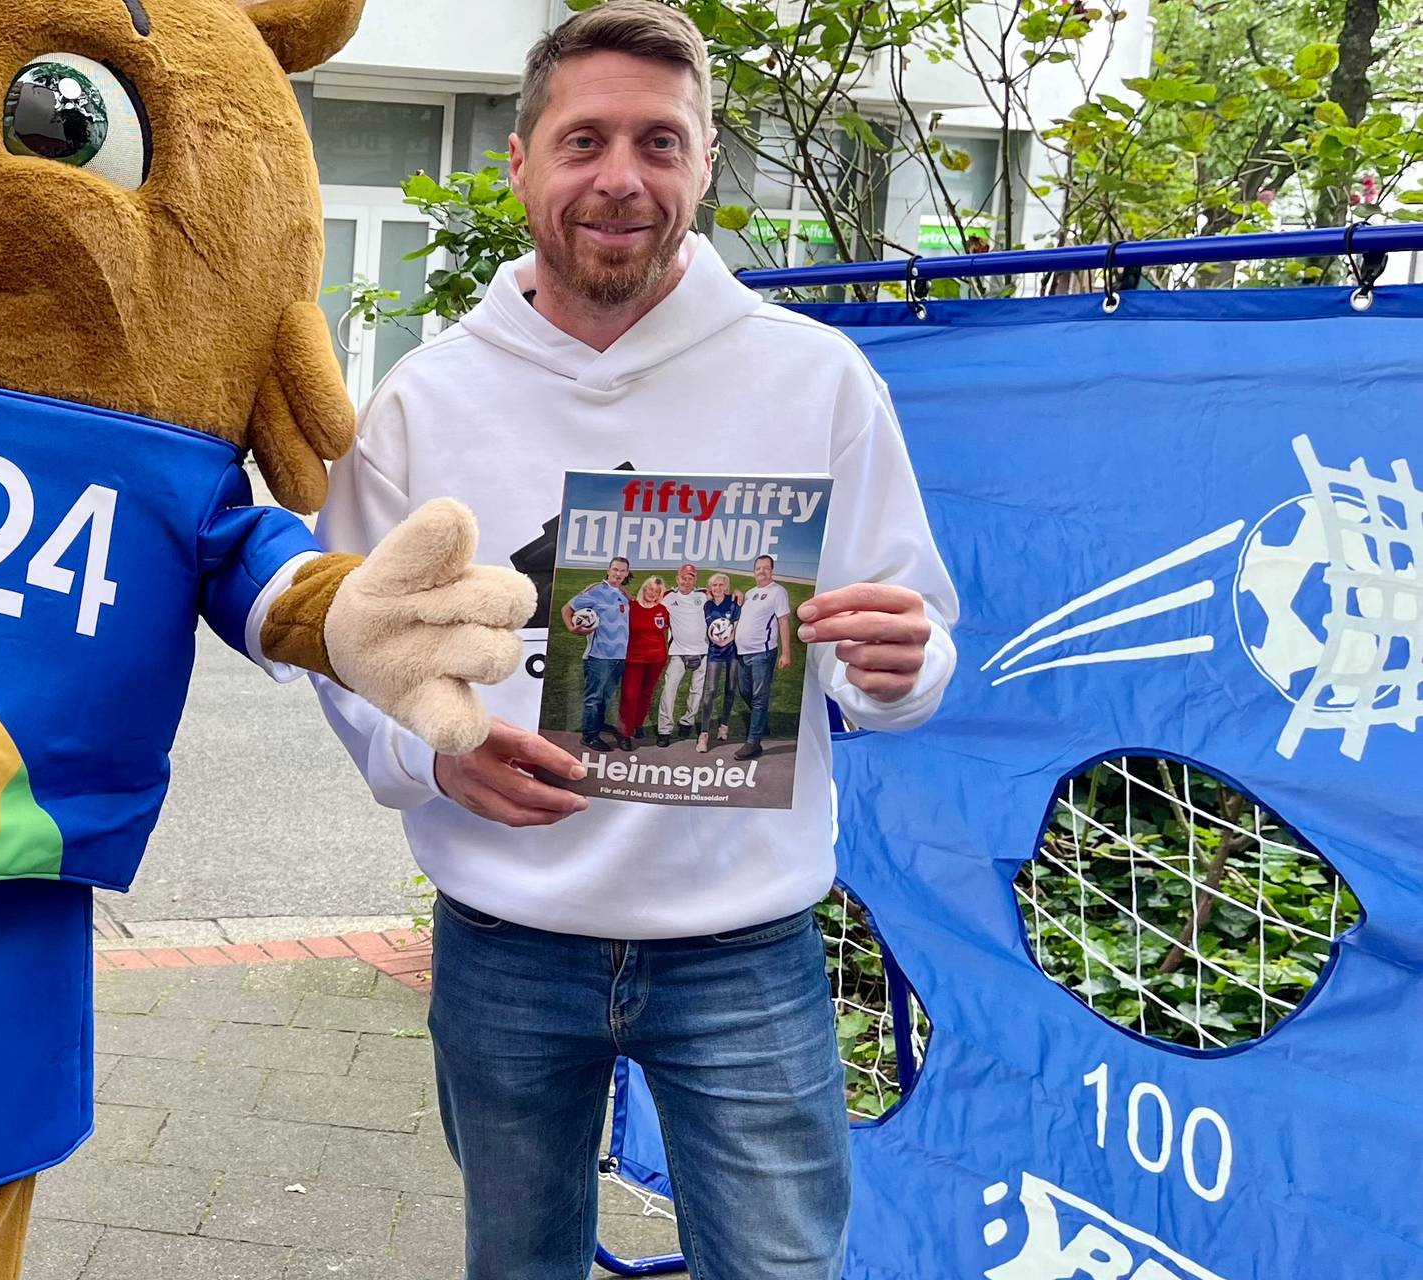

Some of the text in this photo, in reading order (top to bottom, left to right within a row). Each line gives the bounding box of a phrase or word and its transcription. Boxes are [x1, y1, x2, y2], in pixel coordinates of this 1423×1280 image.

[622, 480, 823, 523] fiftyfifty
[618, 516, 783, 561] FREUNDE
[580, 752, 756, 792] Heimspiel
[643, 791, 664, 799] EURO
[1083, 1062, 1233, 1203] 100
